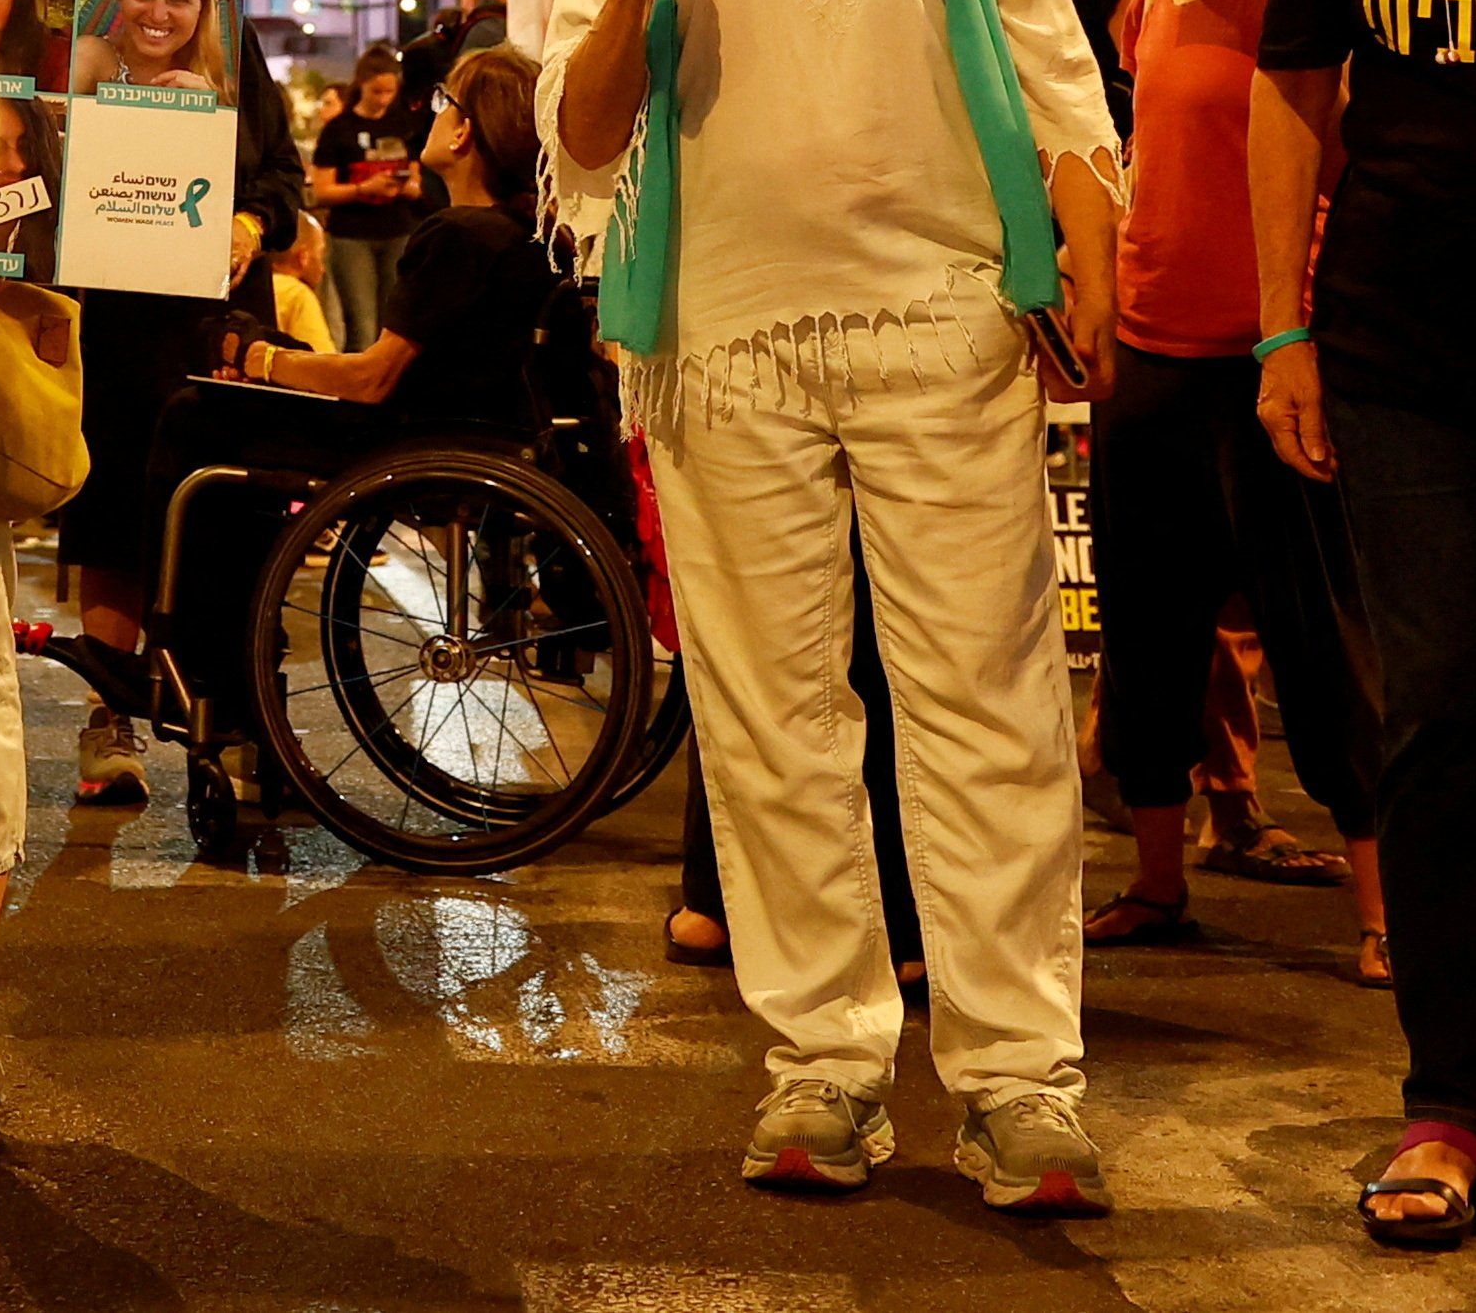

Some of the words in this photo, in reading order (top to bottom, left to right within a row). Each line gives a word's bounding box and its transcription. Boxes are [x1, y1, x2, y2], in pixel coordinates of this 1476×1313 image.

[99, 88, 176, 105] שטיינברכר
[180, 95, 213, 108] דורון
[112, 172, 144, 185] نساء
[146, 176, 176, 187] נשים
[89, 187, 133, 201] يصنعن
[135, 189, 176, 201] עושות
[95, 200, 140, 214] السلام
[142, 203, 175, 215] שלום
